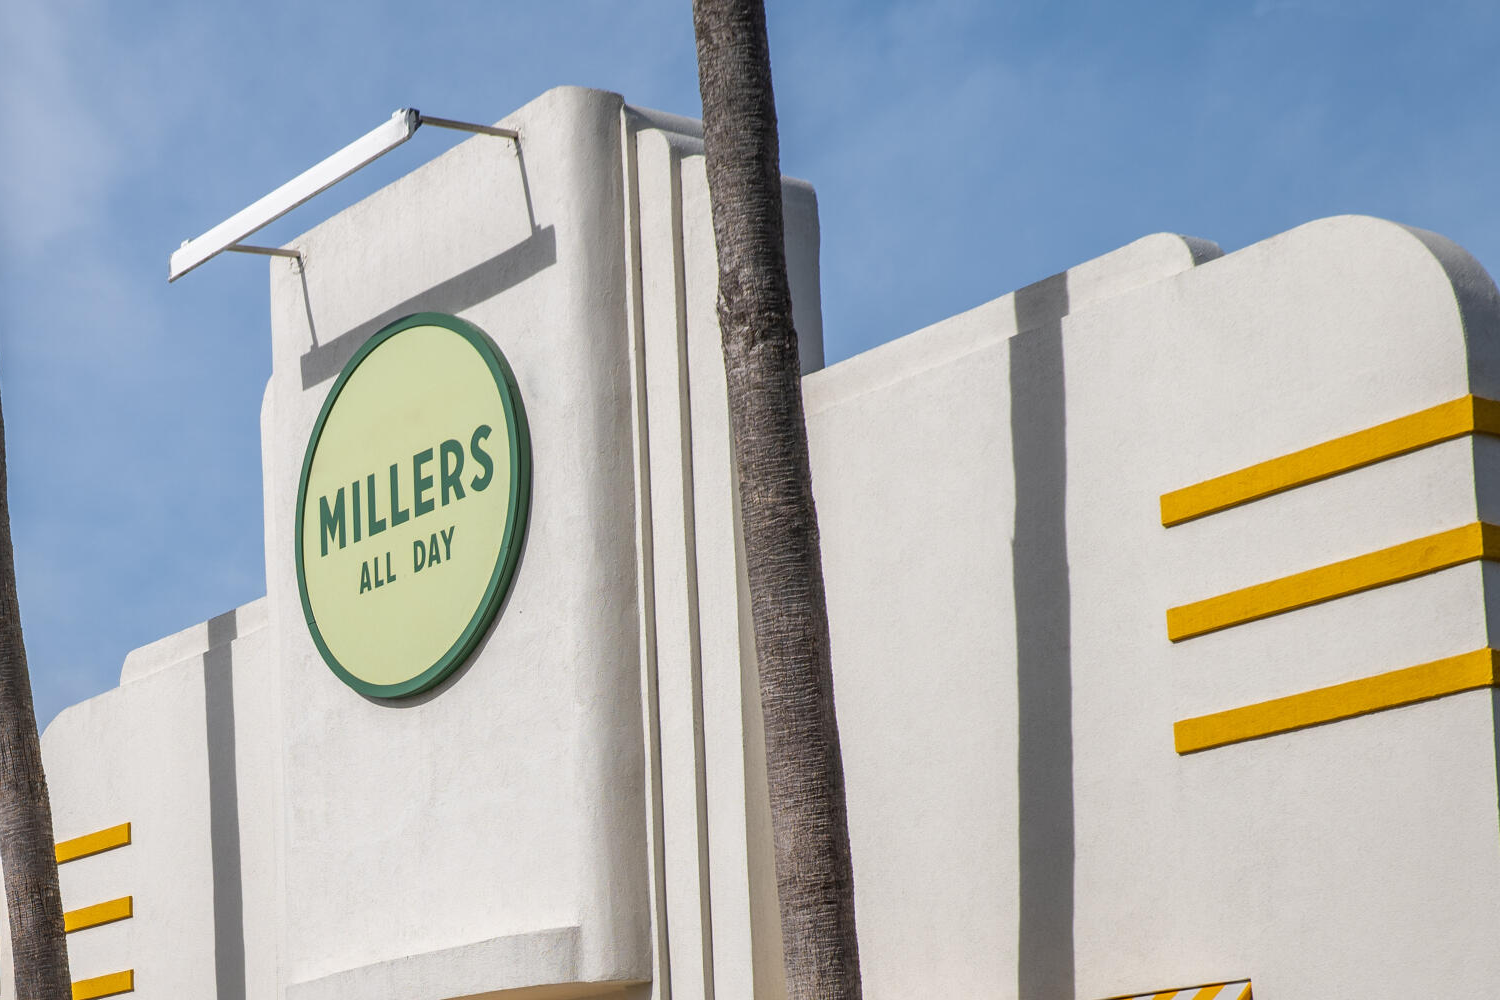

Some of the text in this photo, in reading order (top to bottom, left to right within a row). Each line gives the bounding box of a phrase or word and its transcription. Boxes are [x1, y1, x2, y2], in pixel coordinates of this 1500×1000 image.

[319, 424, 495, 557] MILLERS
[359, 525, 456, 594] ALL DAY
